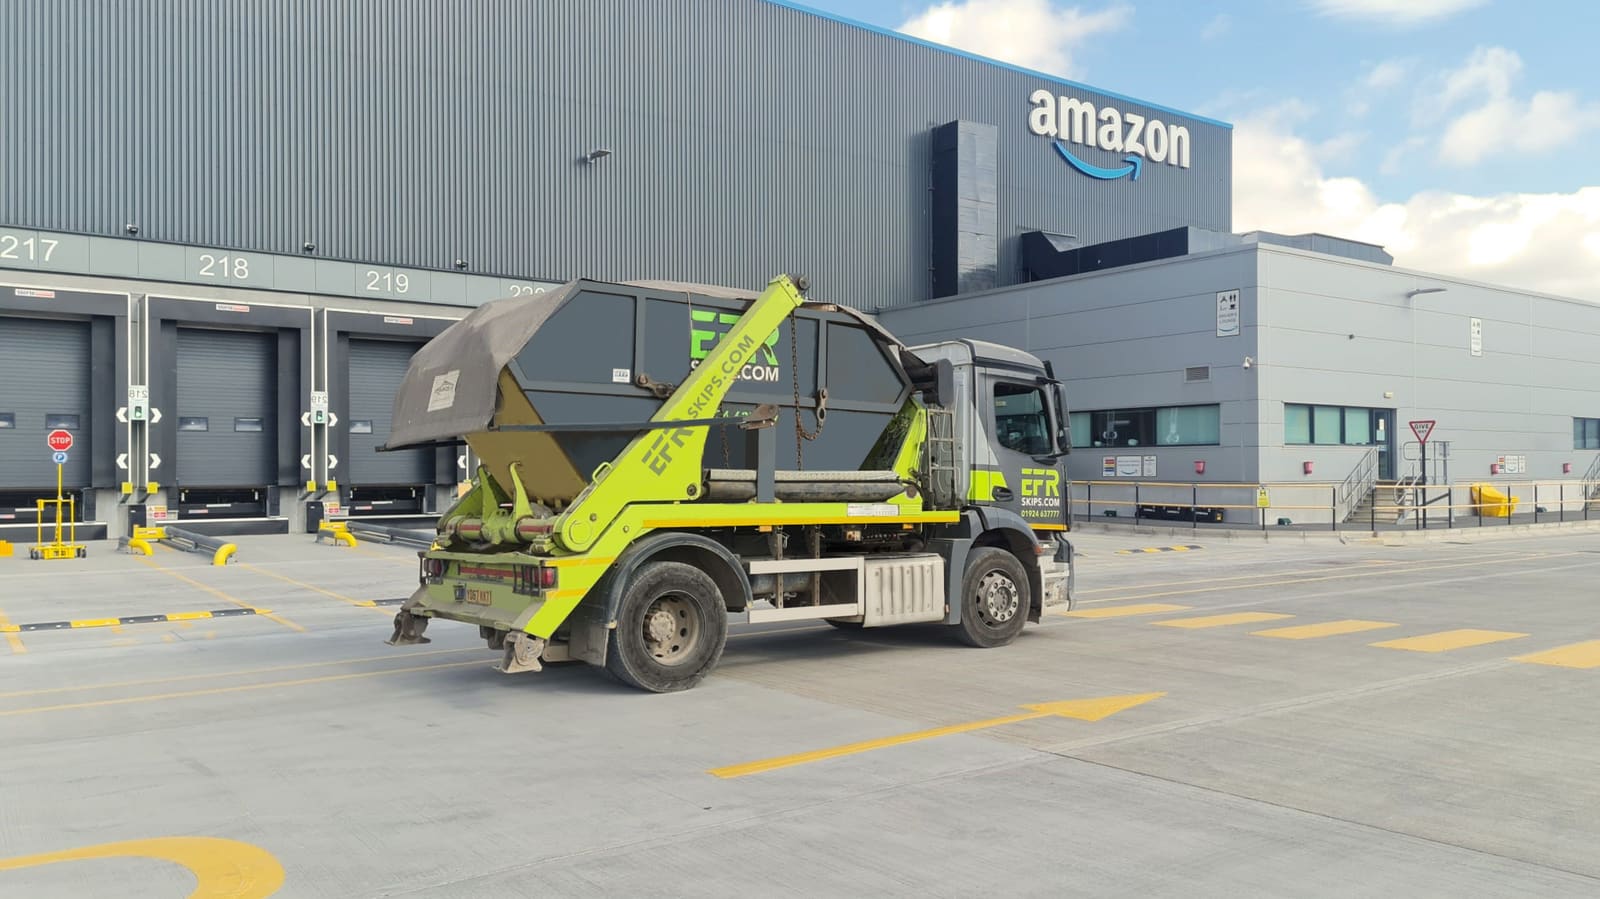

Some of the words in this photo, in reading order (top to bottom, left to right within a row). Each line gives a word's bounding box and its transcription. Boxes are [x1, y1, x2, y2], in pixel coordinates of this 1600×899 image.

[1029, 89, 1190, 168] amazon
[0, 235, 59, 262] 217
[199, 255, 249, 280] 218
[366, 271, 409, 294] 219
[687, 334, 755, 419] SKIPS.COM
[50, 436, 71, 445] STOP
[1021, 468, 1060, 497] EFR
[1021, 497, 1060, 507] SKIPS.COM
[1021, 509, 1039, 518] 01924
